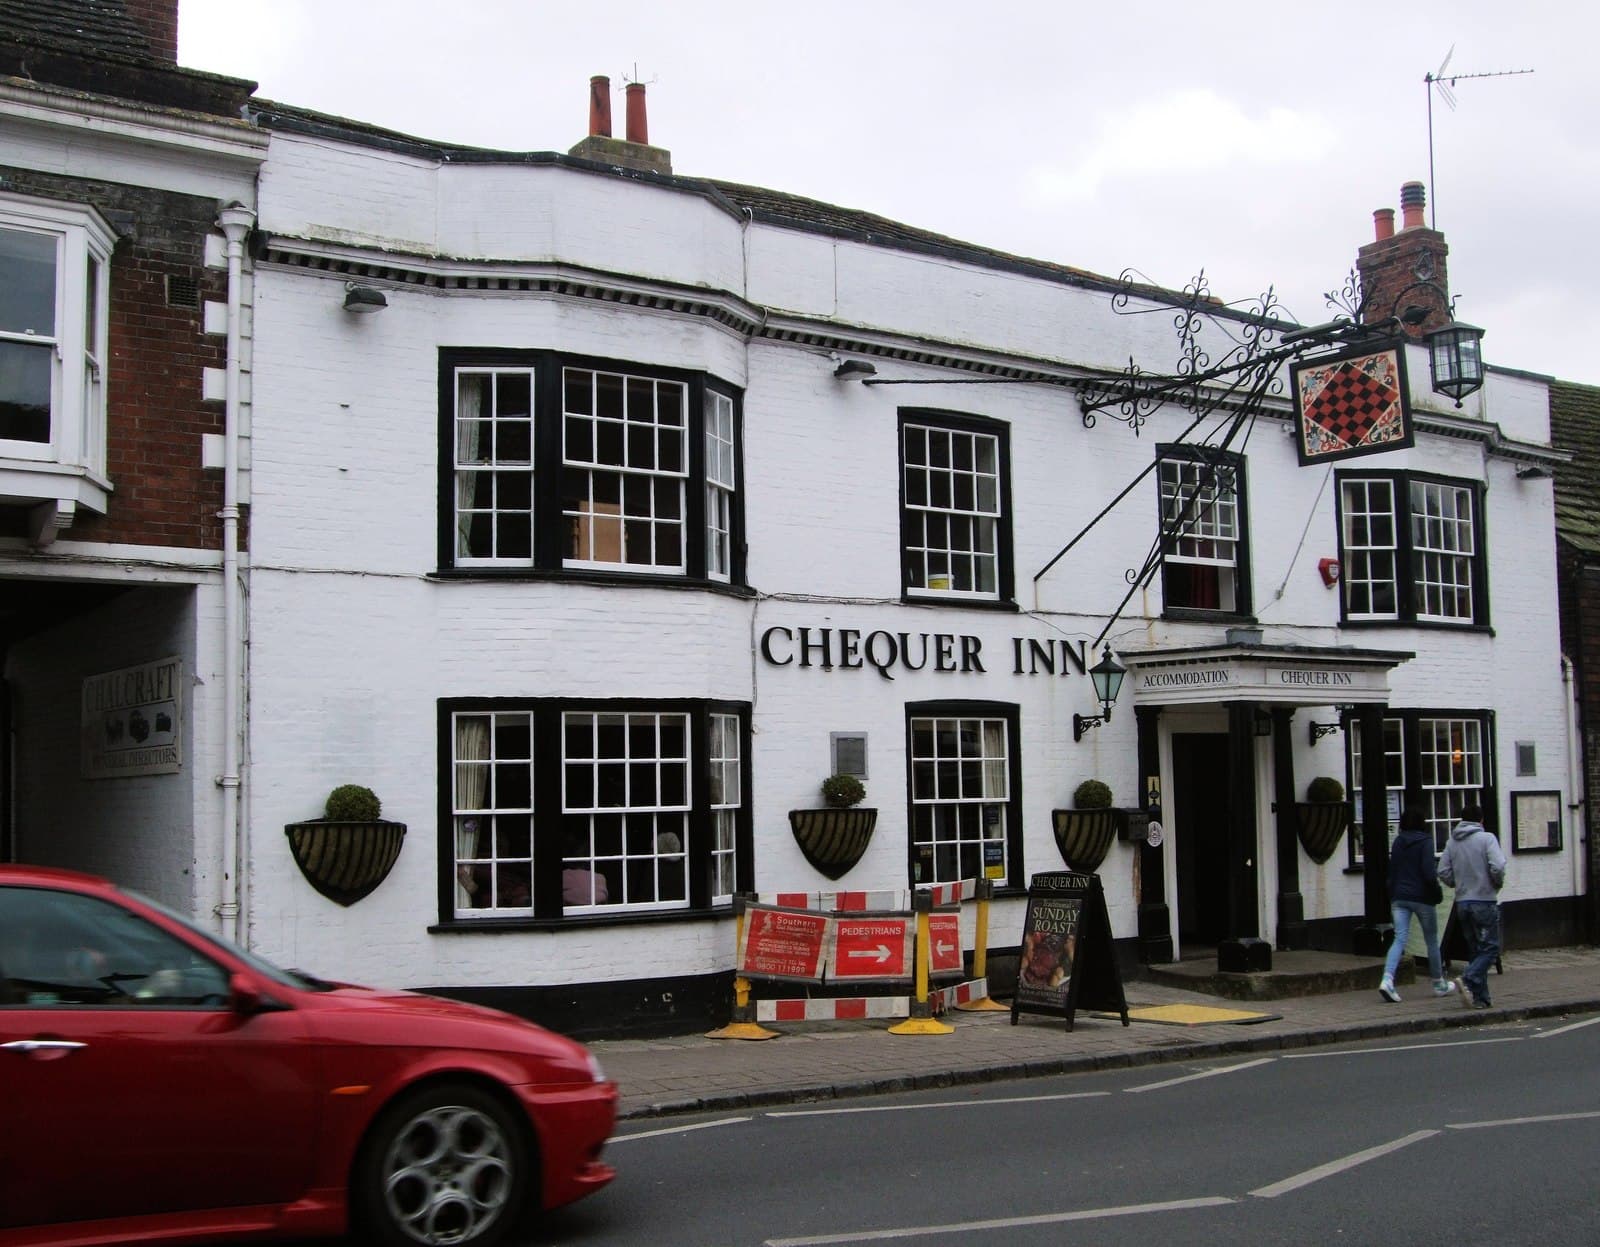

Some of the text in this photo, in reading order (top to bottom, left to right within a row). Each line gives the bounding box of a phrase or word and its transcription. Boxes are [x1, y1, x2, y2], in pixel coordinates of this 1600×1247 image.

[760, 626, 1088, 680] CHEQUER INN
[1144, 670, 1229, 687] ACCOMMODATION
[1281, 670, 1352, 685] CHEQUER INN
[1032, 876, 1089, 890] CHEQUER INN
[1033, 907, 1080, 922] SUNDAY
[777, 916, 816, 928] Southern
[1035, 920, 1075, 934] ROAST
[841, 927, 902, 936] PEDESTRIANS
